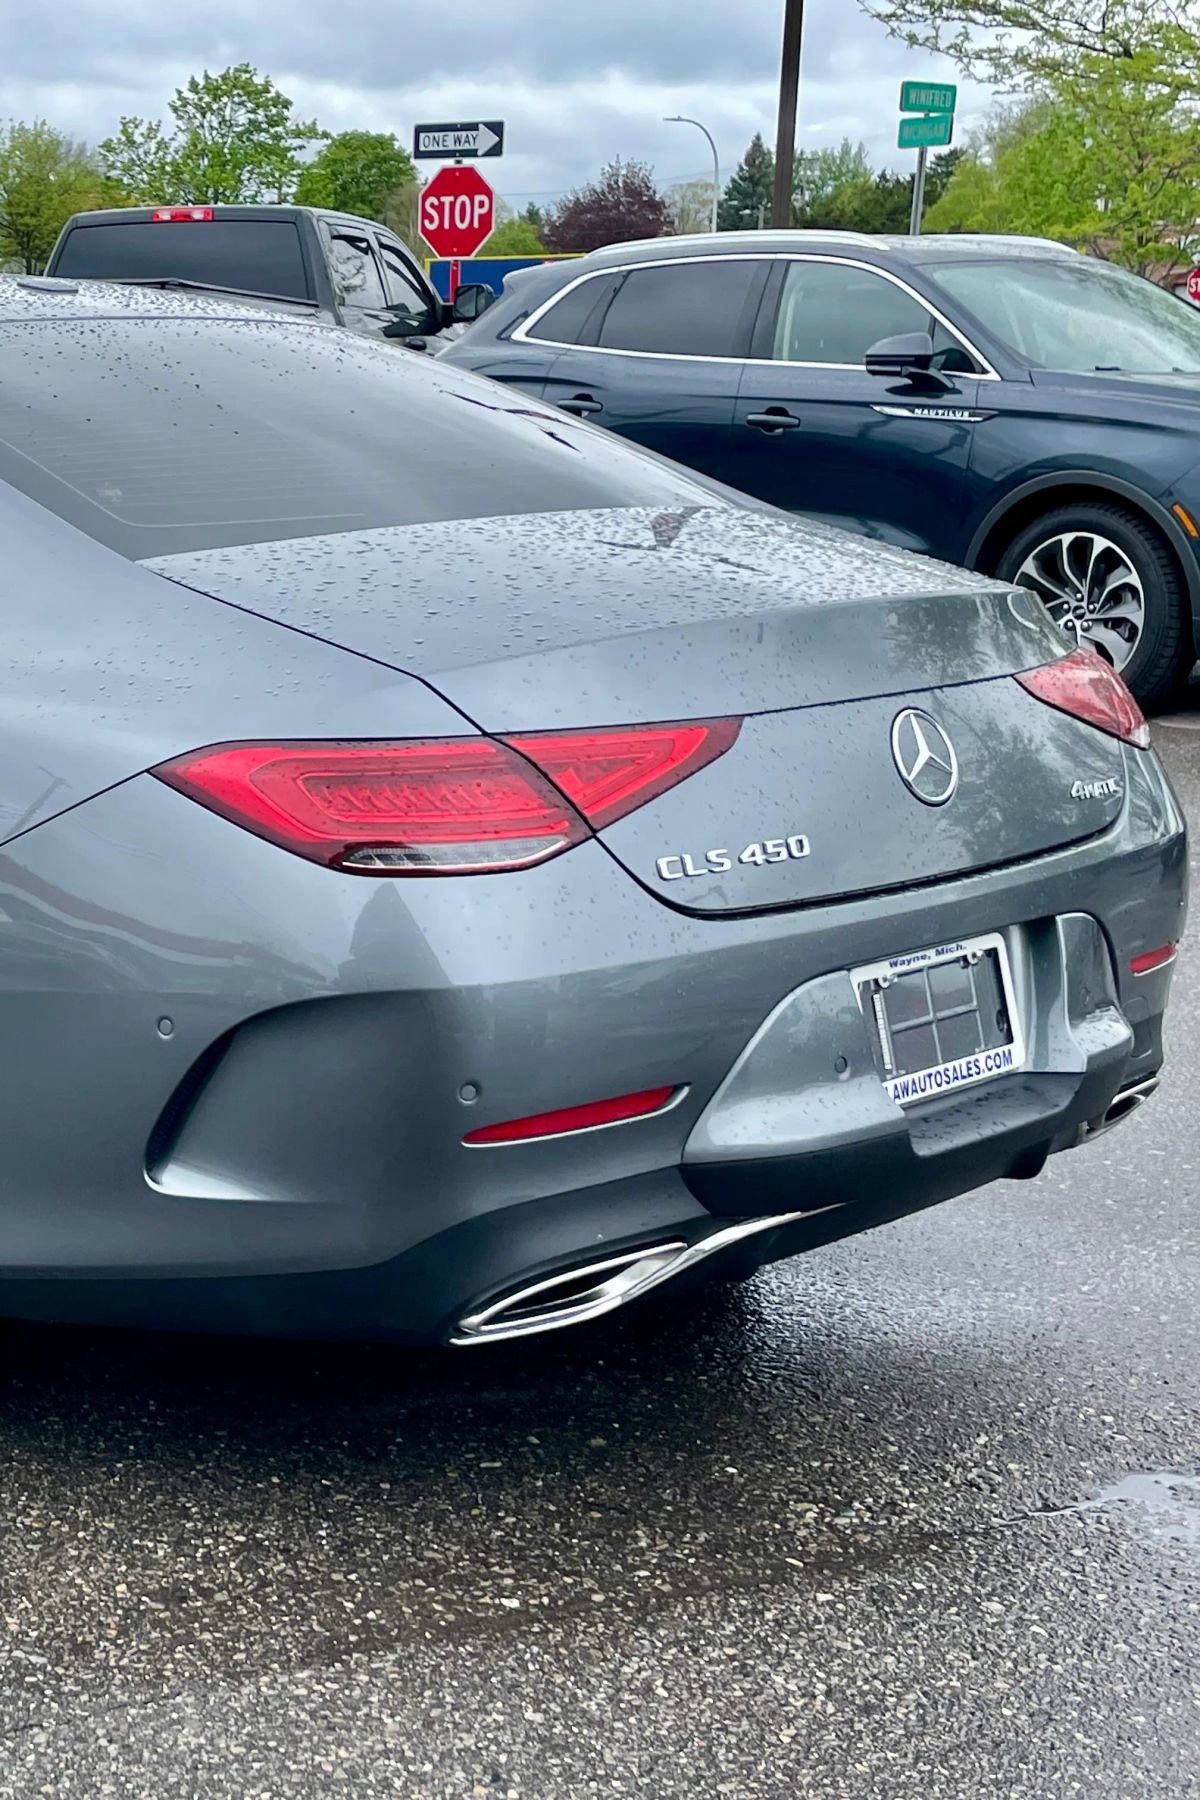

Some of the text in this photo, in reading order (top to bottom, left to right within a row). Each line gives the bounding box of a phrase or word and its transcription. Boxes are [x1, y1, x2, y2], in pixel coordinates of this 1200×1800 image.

[909, 88, 952, 108] WINIFRED
[422, 133, 479, 149] ONE WAY
[423, 194, 490, 231] STOP
[913, 408, 969, 418] NAUTILUS
[656, 834, 811, 881] CLS 450
[888, 943, 968, 969] Wayne, Mich.
[886, 1048, 1014, 1102] AWAUTOSALES.COM
